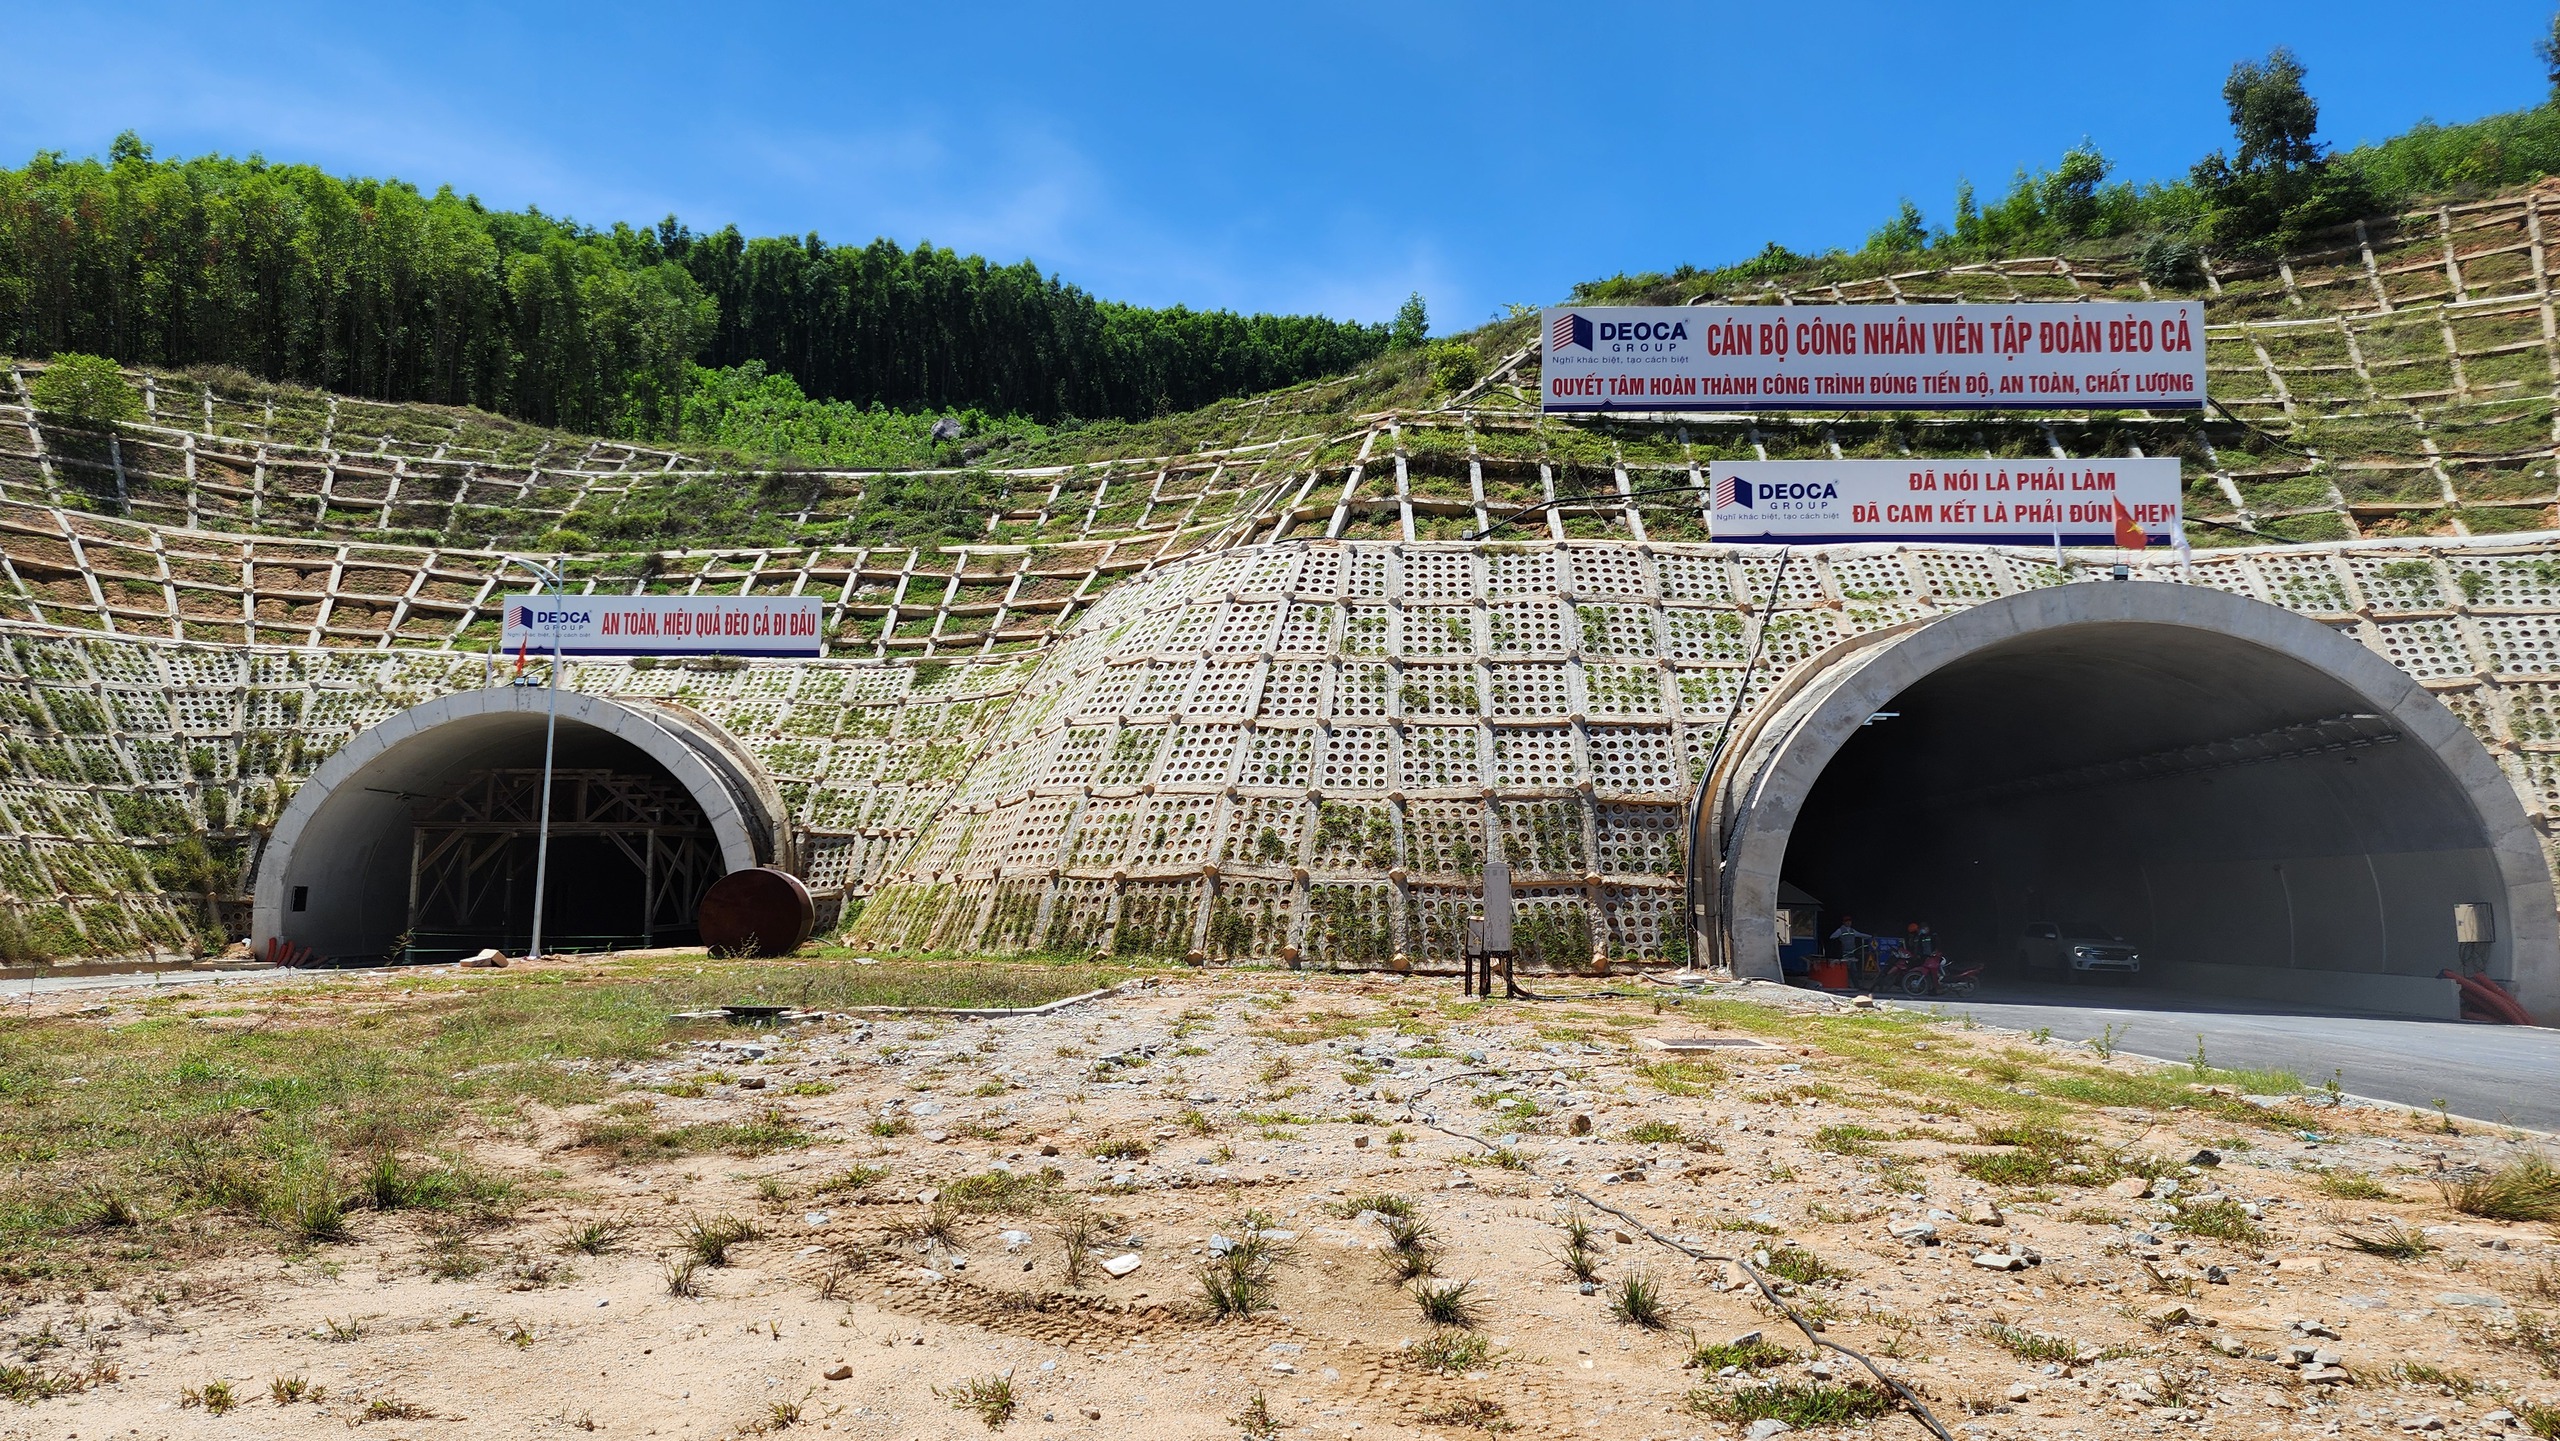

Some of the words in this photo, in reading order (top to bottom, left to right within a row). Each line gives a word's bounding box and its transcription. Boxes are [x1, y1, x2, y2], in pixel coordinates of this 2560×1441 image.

[1600, 322, 1688, 341] DEOCA
[1707, 318, 1752, 356] CÁN
[1760, 316, 1789, 363] BỘ
[1796, 316, 1856, 356] CÔNG
[1864, 316, 1925, 355] NHÂN
[1933, 315, 1984, 354] VIÊN
[1990, 315, 2032, 361] TẬP
[2039, 314, 2101, 354] ĐOÀN
[2108, 313, 2153, 353] ĐÈO
[2161, 308, 2192, 352] CẢ
[1612, 343, 1677, 353] GROUP
[1576, 356, 1599, 364] khác
[1602, 356, 1623, 365] biệt,
[1627, 357, 1642, 365] tạo
[1646, 356, 1668, 364] cách
[1670, 355, 1689, 364] biệt
[1552, 372, 1603, 398] QUYẾT
[1608, 374, 1645, 396] TÂM
[1650, 374, 1696, 396] HOÀN
[1701, 374, 1757, 395] THÀNH
[1762, 373, 1809, 395] CÔNG
[1814, 372, 1865, 395] TRÌNH
[1869, 372, 1917, 395] ĐÚNG
[1922, 369, 1960, 394] TIẾN
[1965, 372, 1994, 398] ĐỘ,
[1999, 375, 2024, 394] AN
[2029, 371, 2080, 396] TOÀN,
[2085, 368, 2130, 393] CHẤT
[2136, 372, 2194, 397] LƯỢNG
[1909, 469, 1937, 491] ĐÃ
[1944, 468, 1978, 491] NÓI
[1985, 468, 2010, 491] LÀ
[2016, 466, 2065, 491] PHẢI
[2072, 468, 2116, 491] LÀM
[1759, 483, 1838, 500] DEOCA
[1770, 502, 1828, 510] GROUP
[1852, 501, 1880, 523] ĐÃ
[1887, 504, 1933, 523] CAM
[1940, 498, 1977, 523] KẾT
[1983, 501, 2008, 523] LÀ
[2014, 498, 2063, 523] PHẢI
[2069, 500, 2113, 523] ĐÚN
[2134, 504, 2176, 526] HẸN
[1738, 513, 1759, 521] khác
[1823, 512, 1840, 520] biệt
[602, 612, 620, 635] AN
[623, 608, 659, 638] TOÀN,
[663, 608, 692, 640] HIỆU
[696, 605, 721, 638] QUẢ
[725, 608, 749, 636] ĐÈO
[753, 605, 770, 636] CẢ
[773, 613, 786, 636] ĐI
[789, 605, 816, 636] ĐẦU
